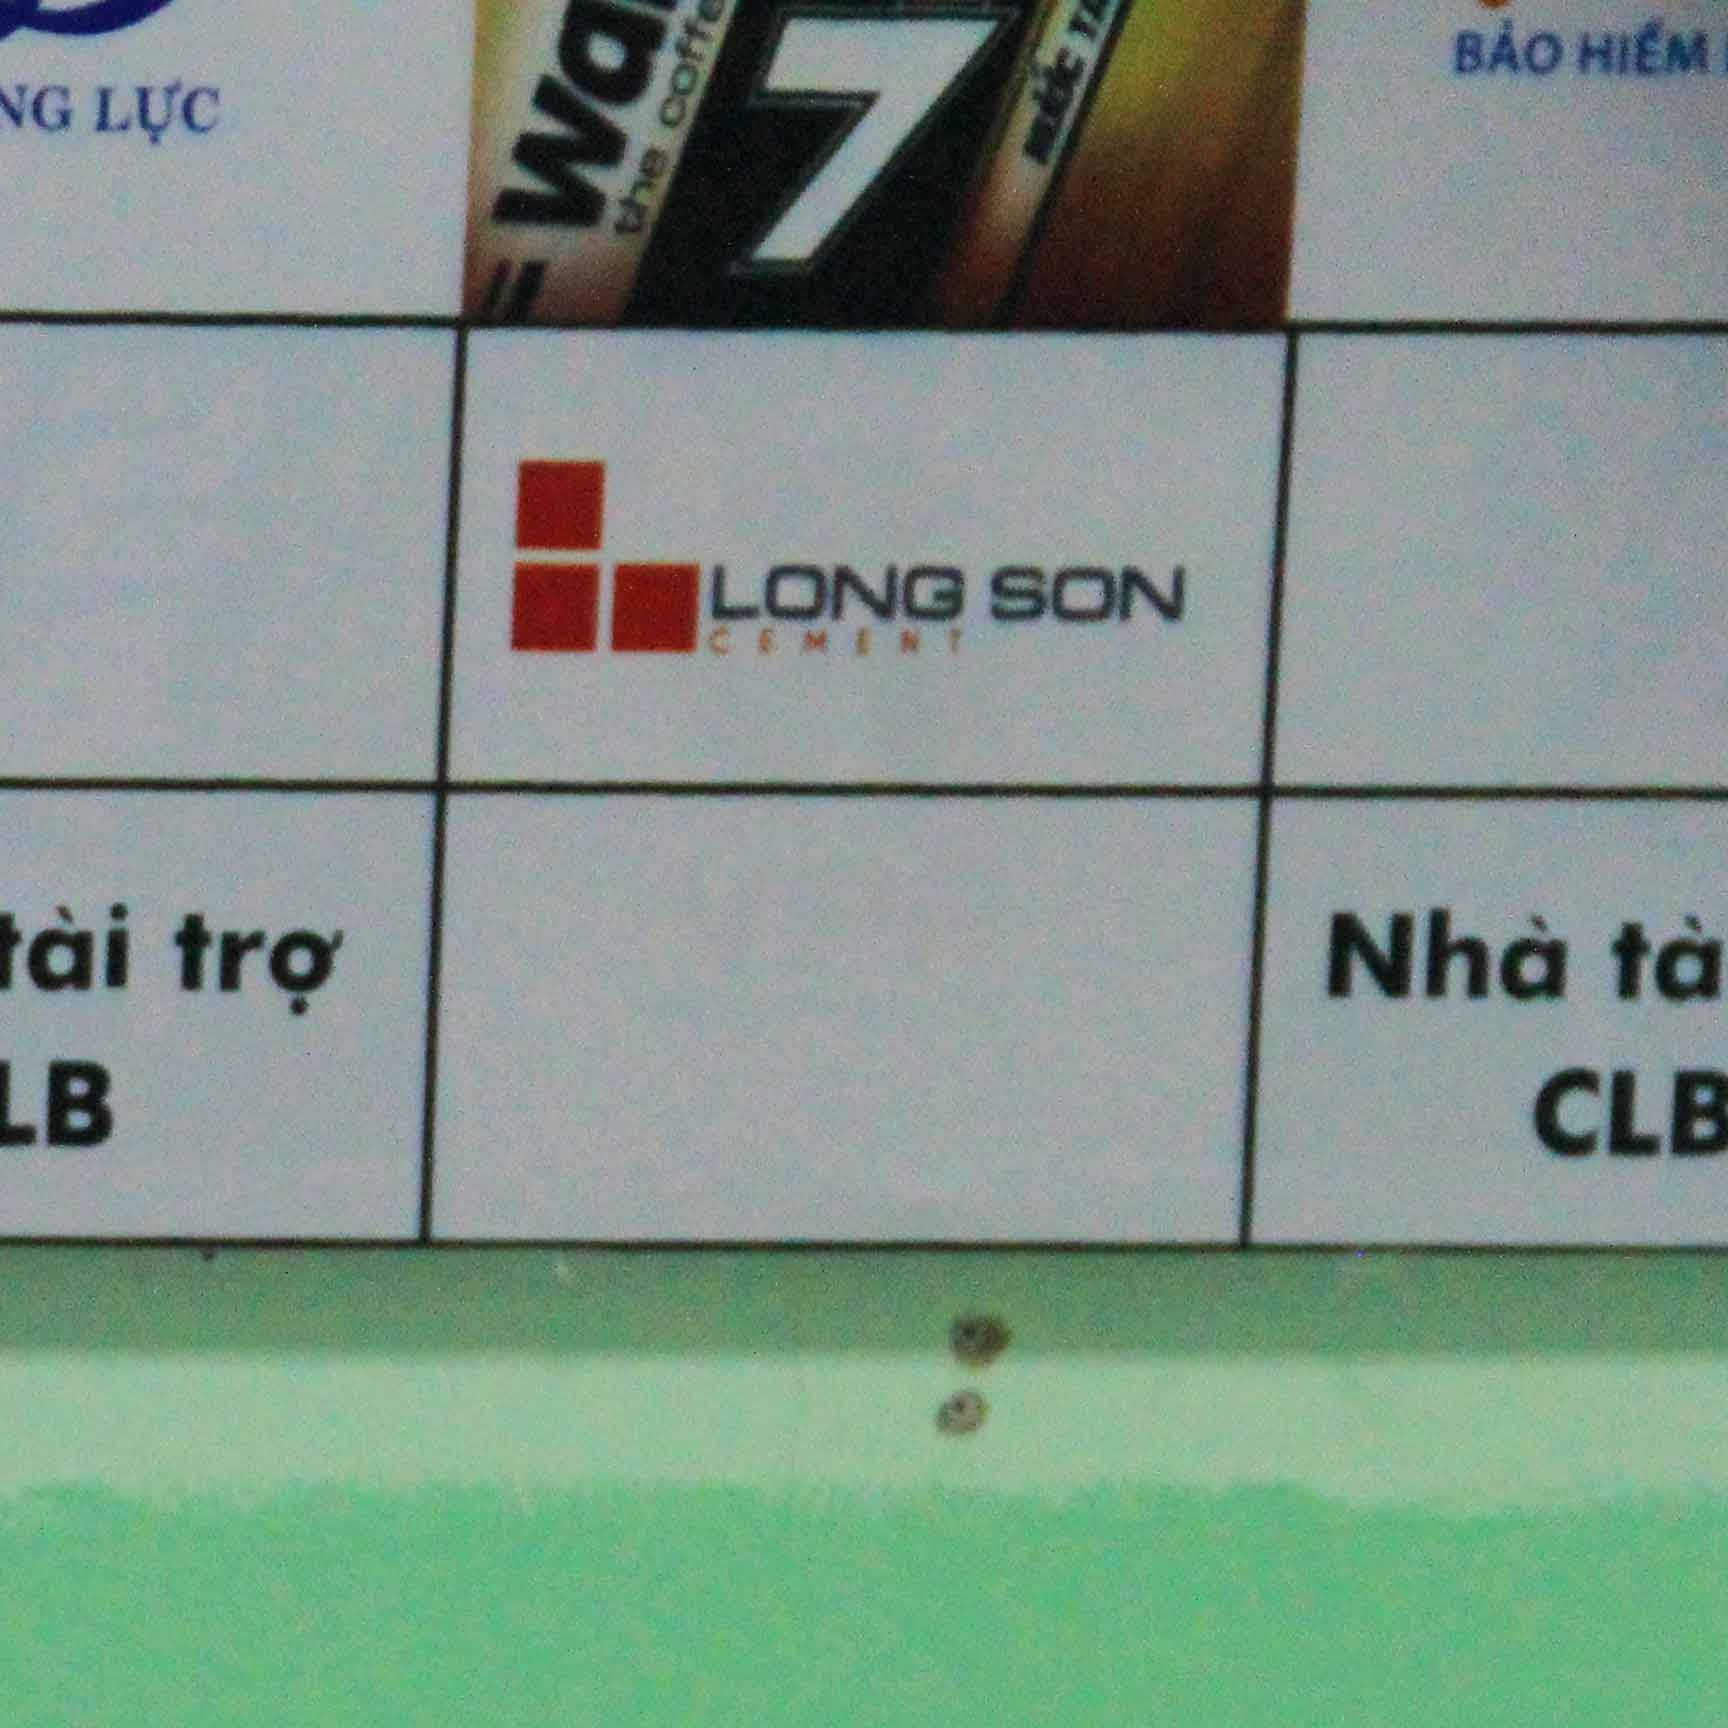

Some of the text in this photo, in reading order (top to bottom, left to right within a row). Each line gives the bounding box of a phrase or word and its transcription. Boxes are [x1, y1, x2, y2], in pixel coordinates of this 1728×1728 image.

[1455, 16, 1709, 74] BẢO HIỂM
[94, 80, 223, 144] LỰC
[711, 564, 1185, 623] LONG SON
[709, 630, 964, 656] CEMENT
[175, 913, 343, 1015] trợ
[1328, 908, 1723, 1002] Nhà tà
[1534, 1067, 1728, 1157] CLB
